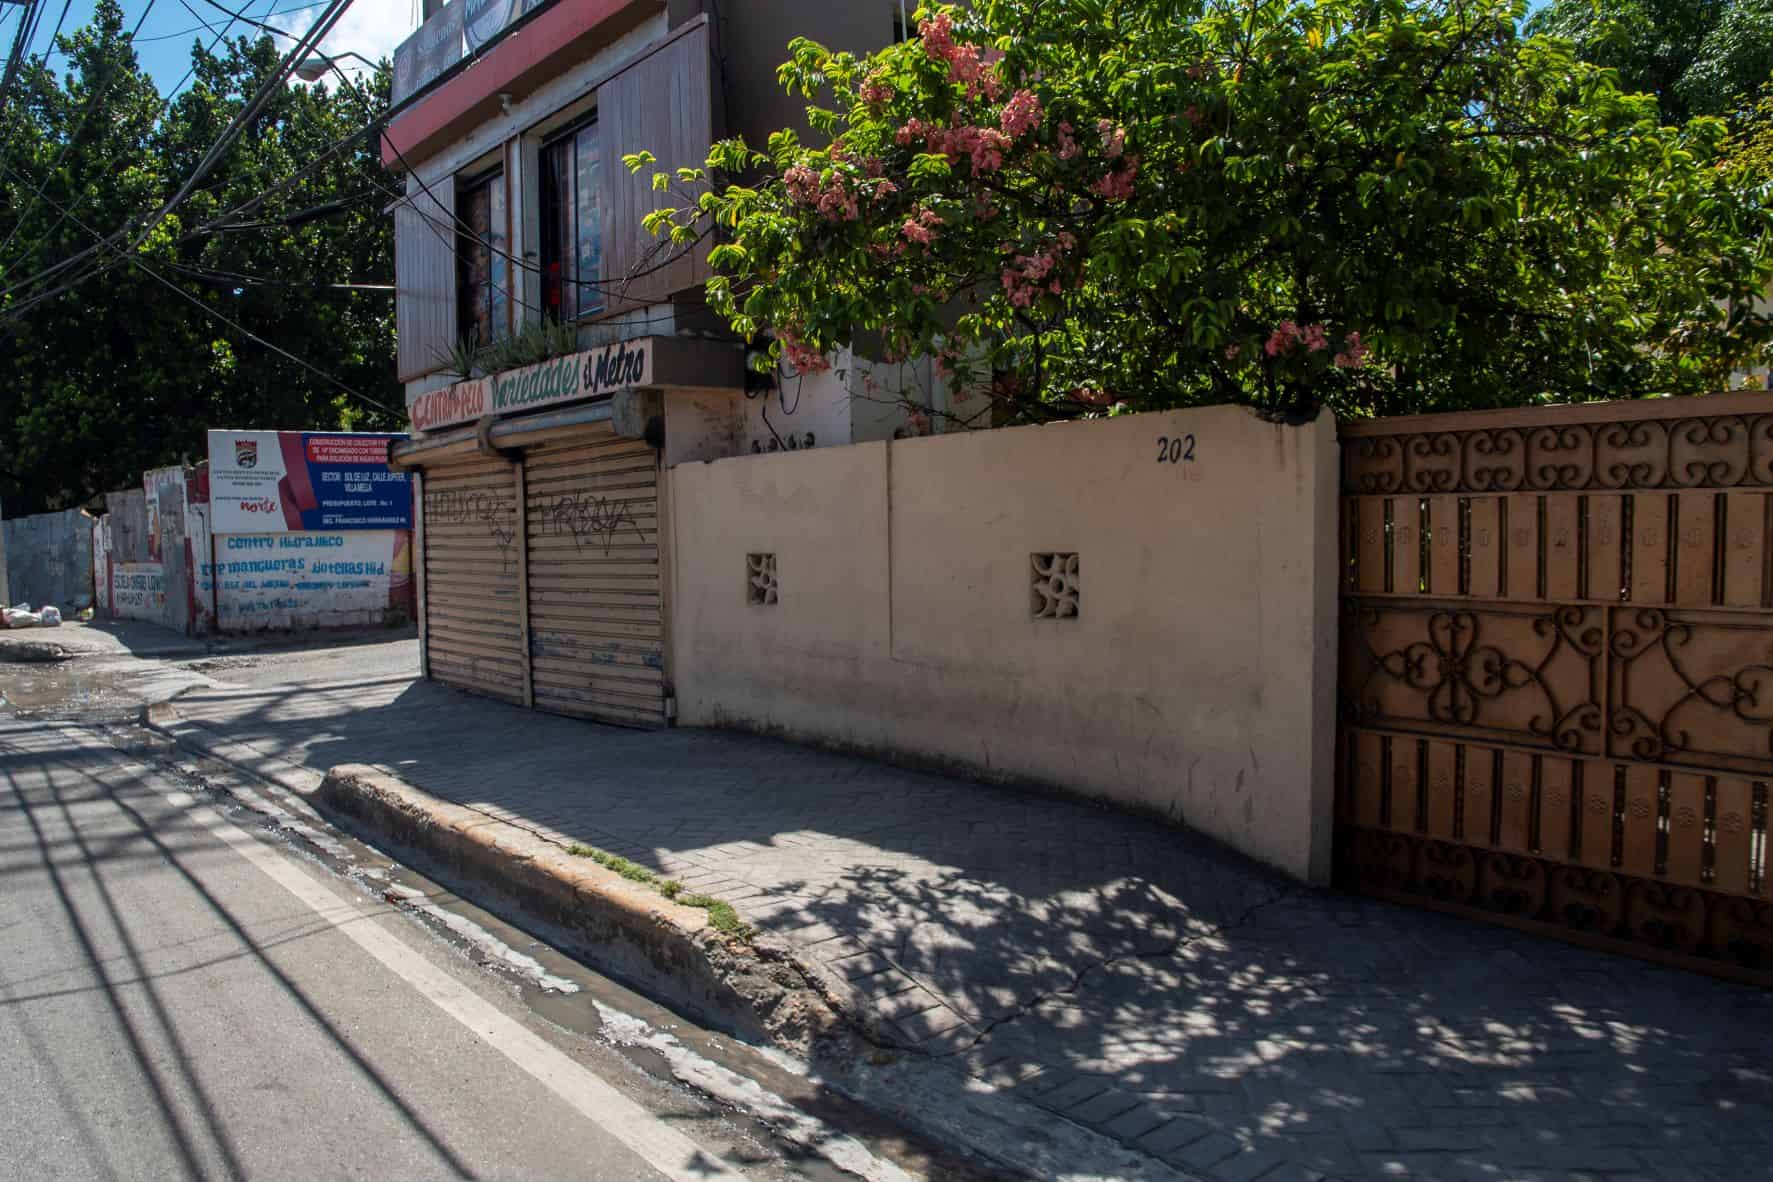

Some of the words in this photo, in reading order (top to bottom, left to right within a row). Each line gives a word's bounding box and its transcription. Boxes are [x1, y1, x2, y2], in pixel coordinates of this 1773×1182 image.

[490, 354, 580, 409] Variedades
[593, 342, 644, 392] Metro
[1157, 434, 1195, 464] 202
[240, 499, 277, 513] norte
